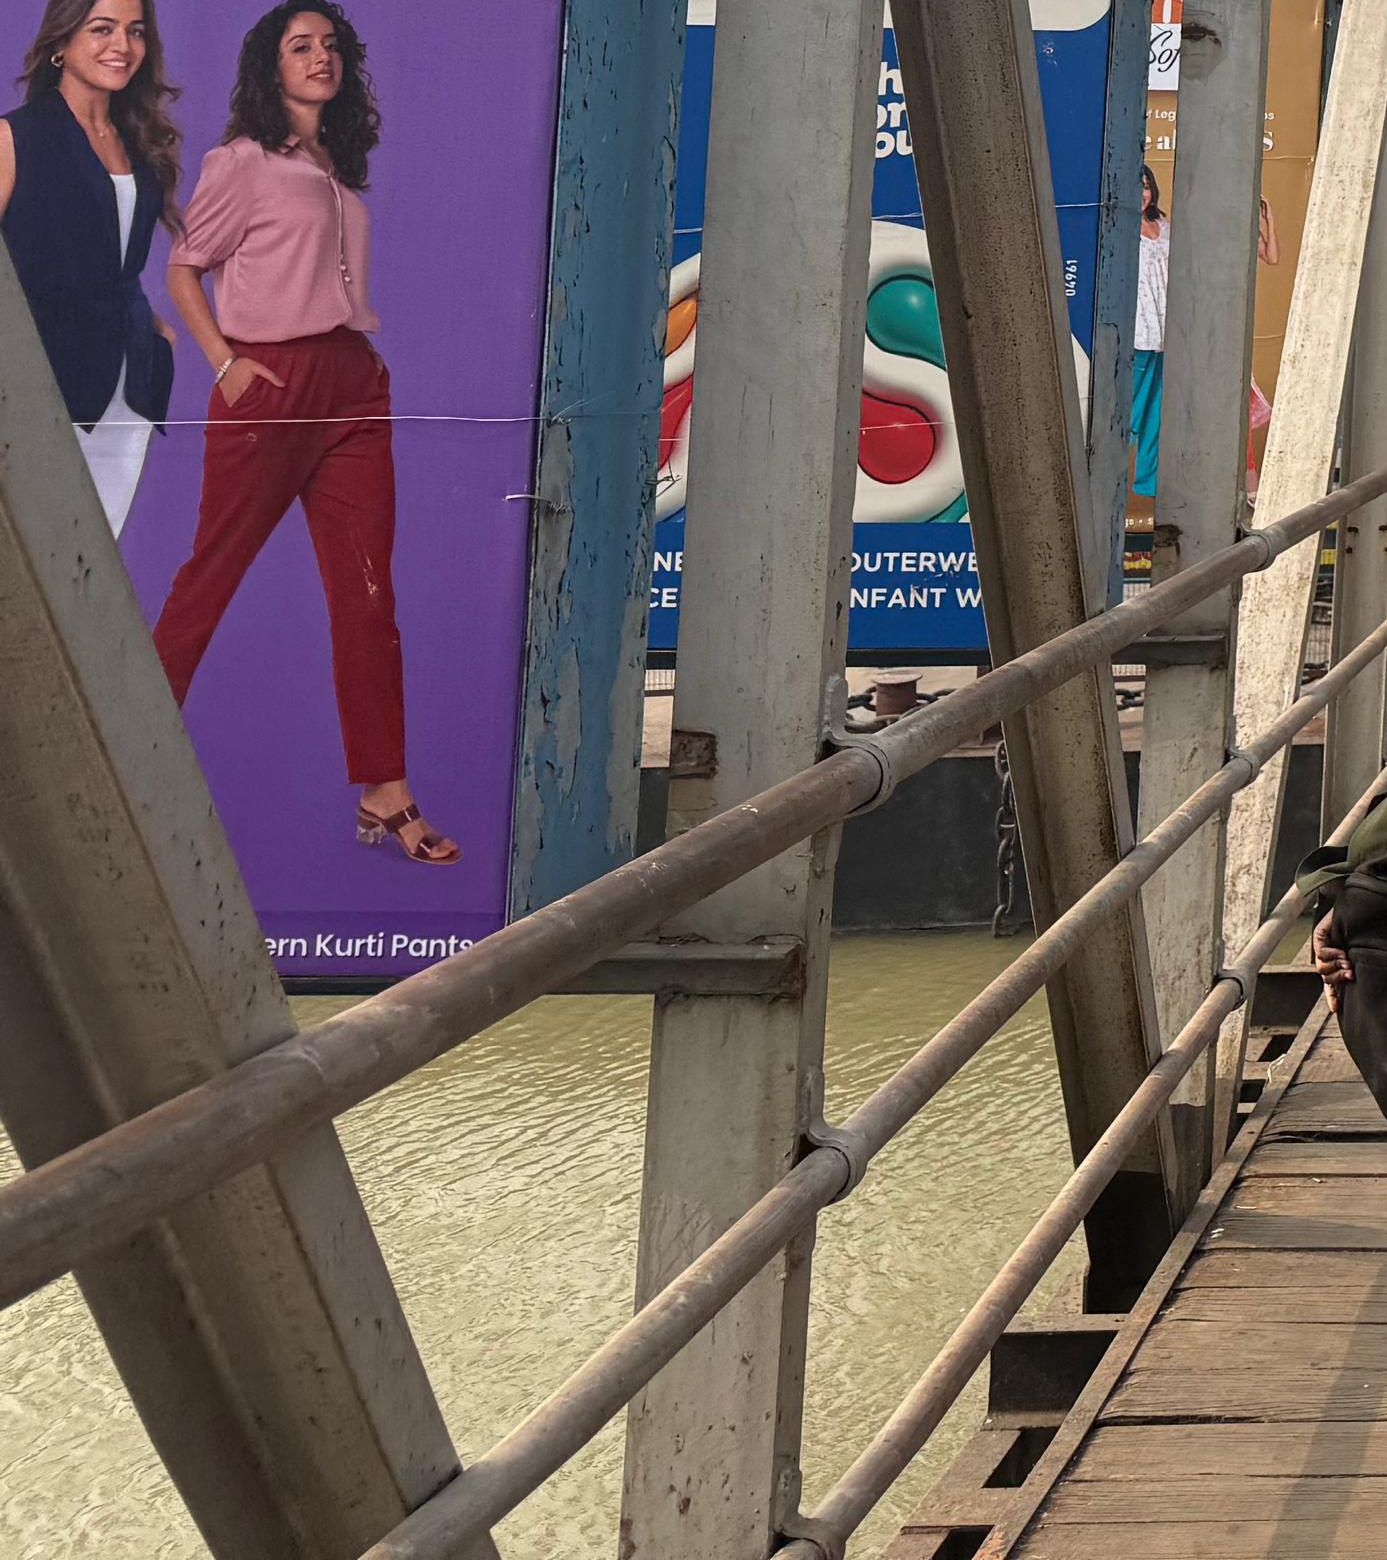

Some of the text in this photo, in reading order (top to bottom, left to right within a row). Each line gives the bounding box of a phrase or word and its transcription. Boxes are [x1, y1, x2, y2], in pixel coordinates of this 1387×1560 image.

[1065, 259, 1078, 297] 04961
[850, 552, 979, 574] OUTERWE
[850, 588, 947, 609] NFANT
[265, 932, 474, 958] ern Kurti Pants
